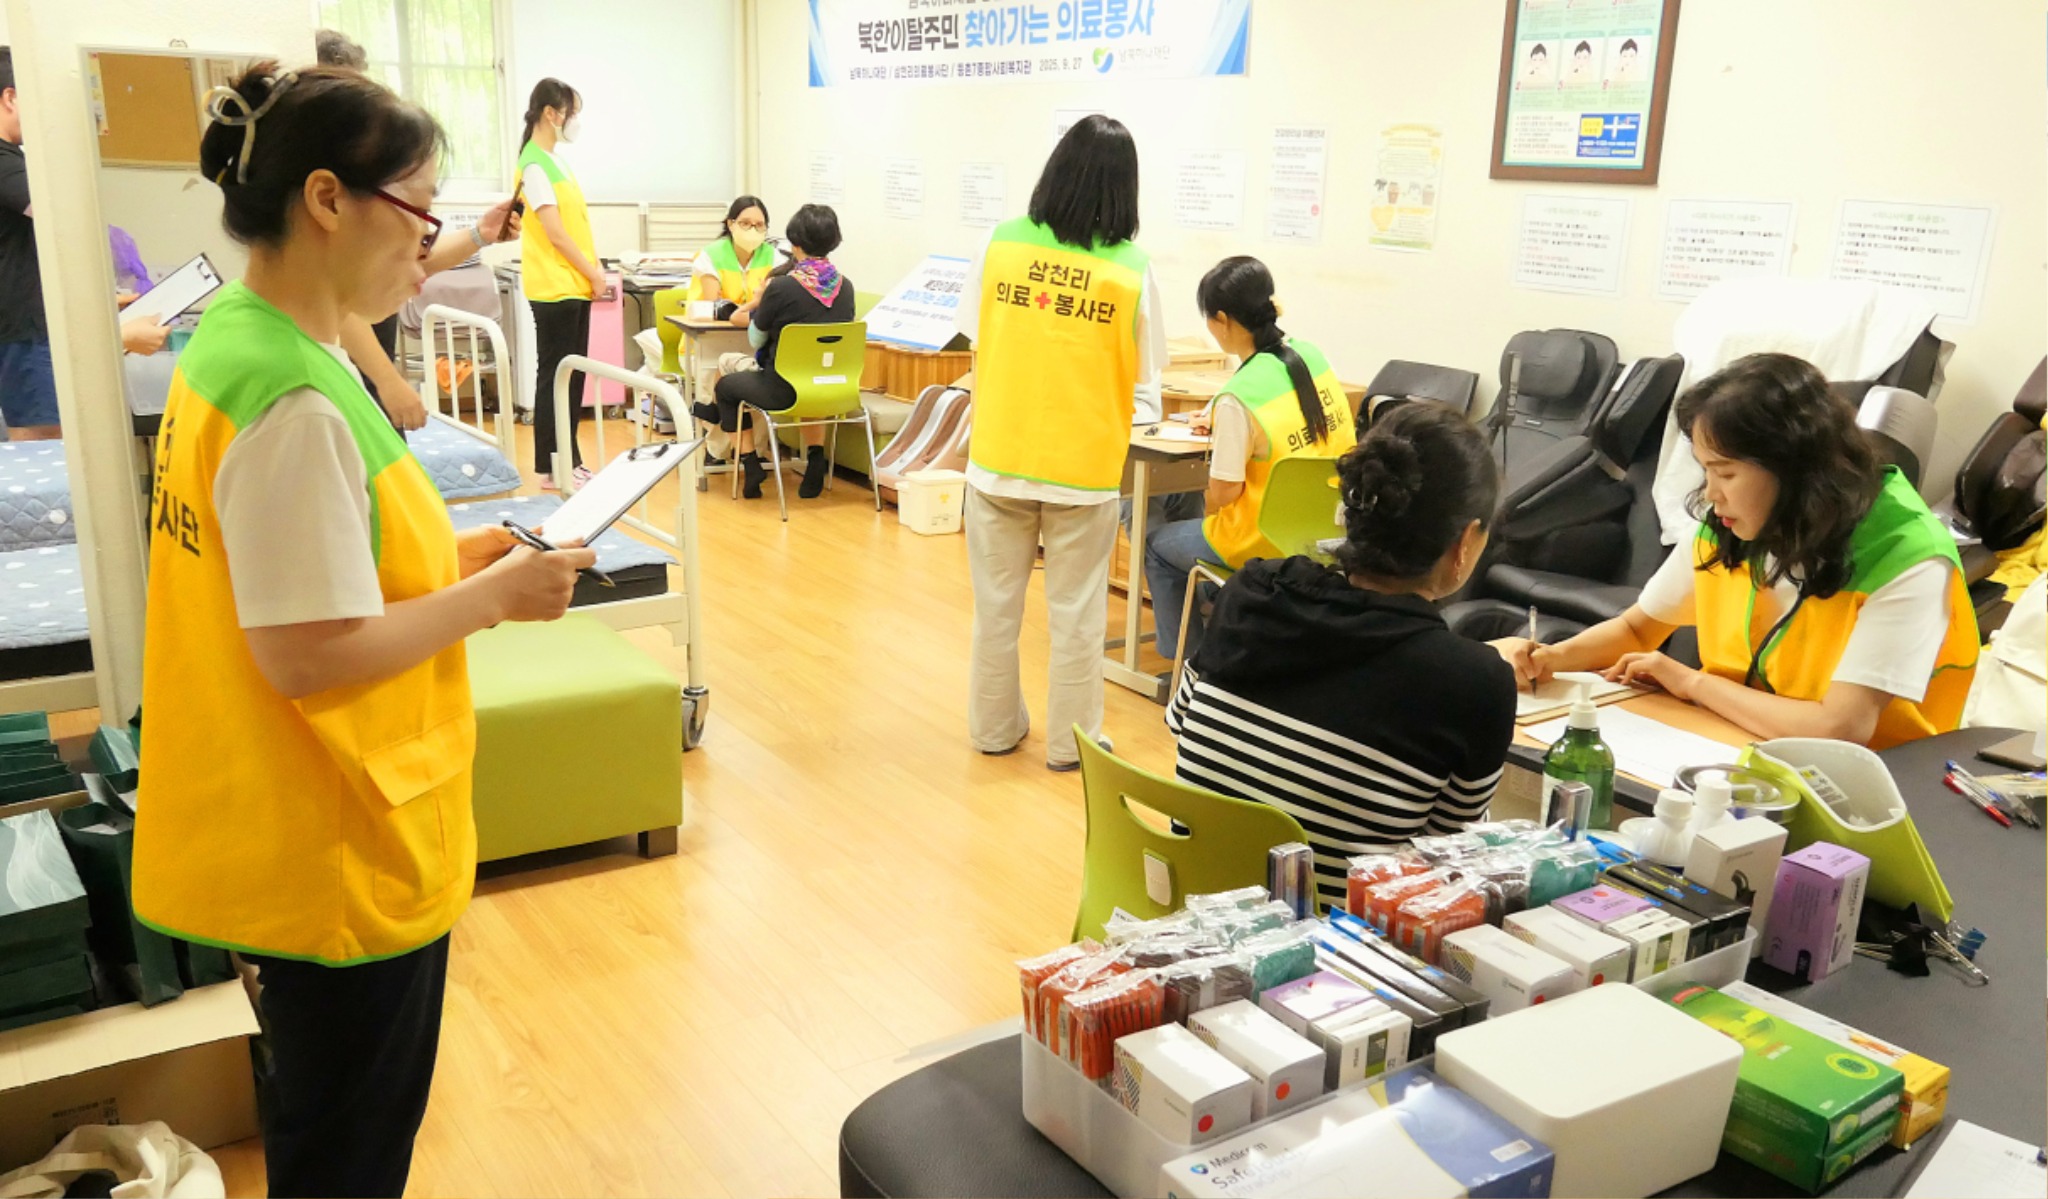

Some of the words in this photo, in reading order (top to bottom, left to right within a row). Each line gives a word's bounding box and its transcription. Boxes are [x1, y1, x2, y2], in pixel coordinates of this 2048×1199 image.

[858, 14, 959, 53] 북한이탈주민
[965, 5, 1049, 48] 찾아가는
[1056, 0, 1155, 41] 의료봉사
[1028, 260, 1091, 291] 삼천리
[997, 282, 1031, 308] 의료
[1054, 294, 1116, 324] 봉사단
[155, 463, 201, 558] 사단
[1208, 1141, 1269, 1169] Medicm
